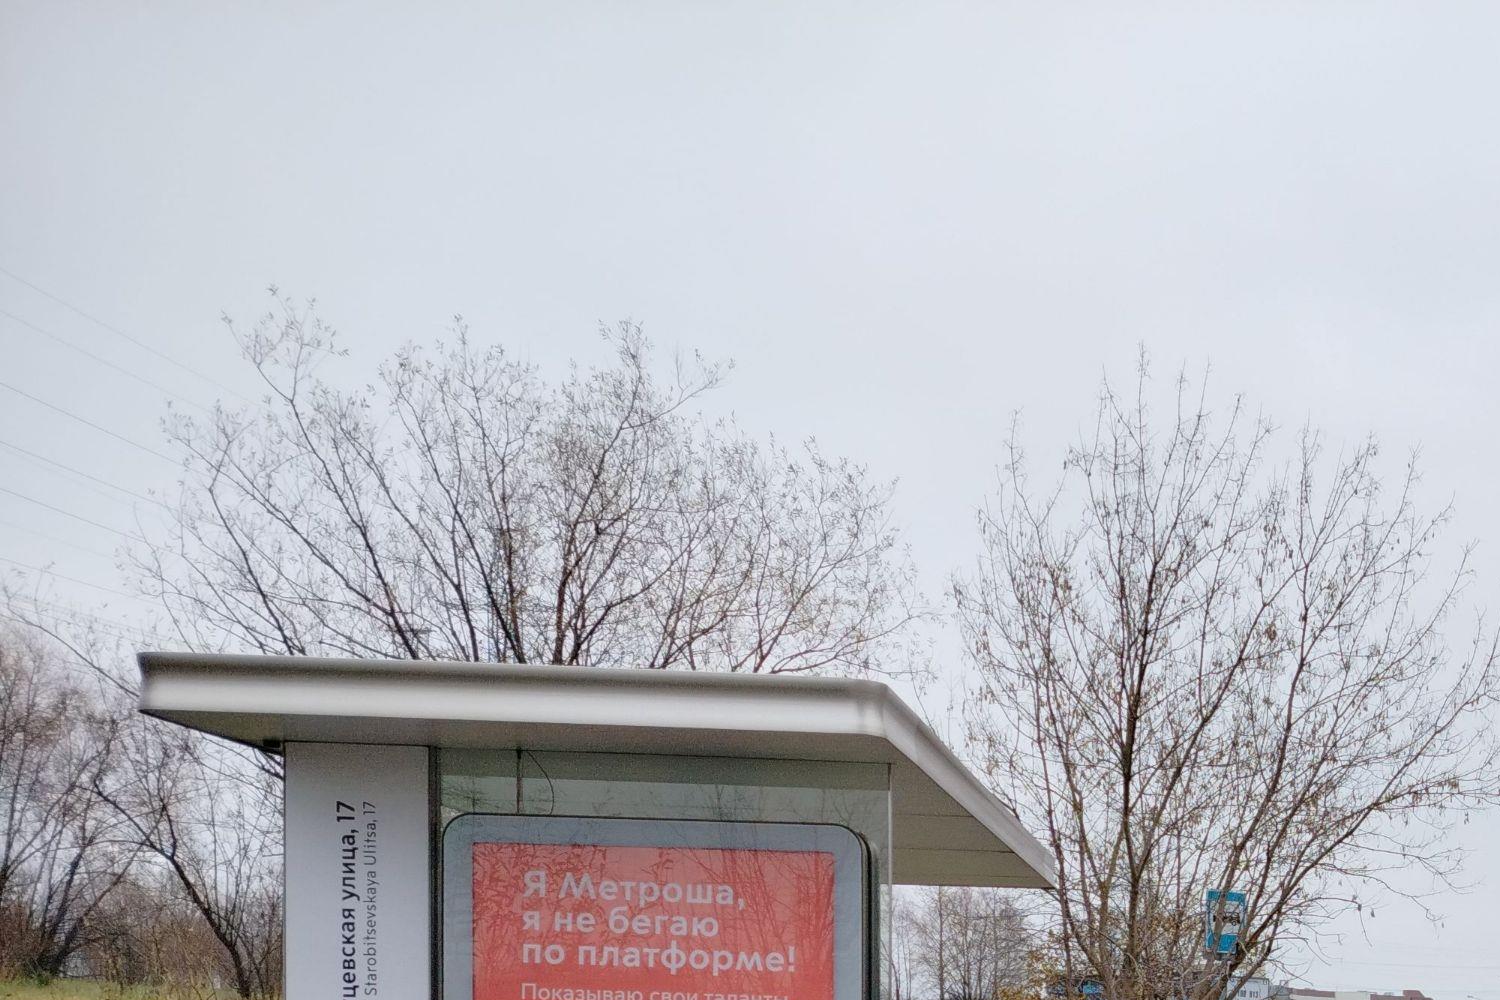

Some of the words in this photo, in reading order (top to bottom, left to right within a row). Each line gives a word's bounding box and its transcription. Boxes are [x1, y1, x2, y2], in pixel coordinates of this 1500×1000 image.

[336, 801, 355, 823] 17
[362, 801, 376, 815] 17
[363, 819, 378, 866] Ulitsa,
[342, 829, 360, 901] улица,
[523, 870, 547, 898] Я
[558, 873, 746, 911] Метроша,
[363, 871, 379, 996] Starobitsevskaya
[522, 911, 541, 932] я
[554, 911, 597, 933] не
[608, 907, 719, 938] бегаю
[522, 943, 565, 965] по
[578, 940, 797, 977] платформе!
